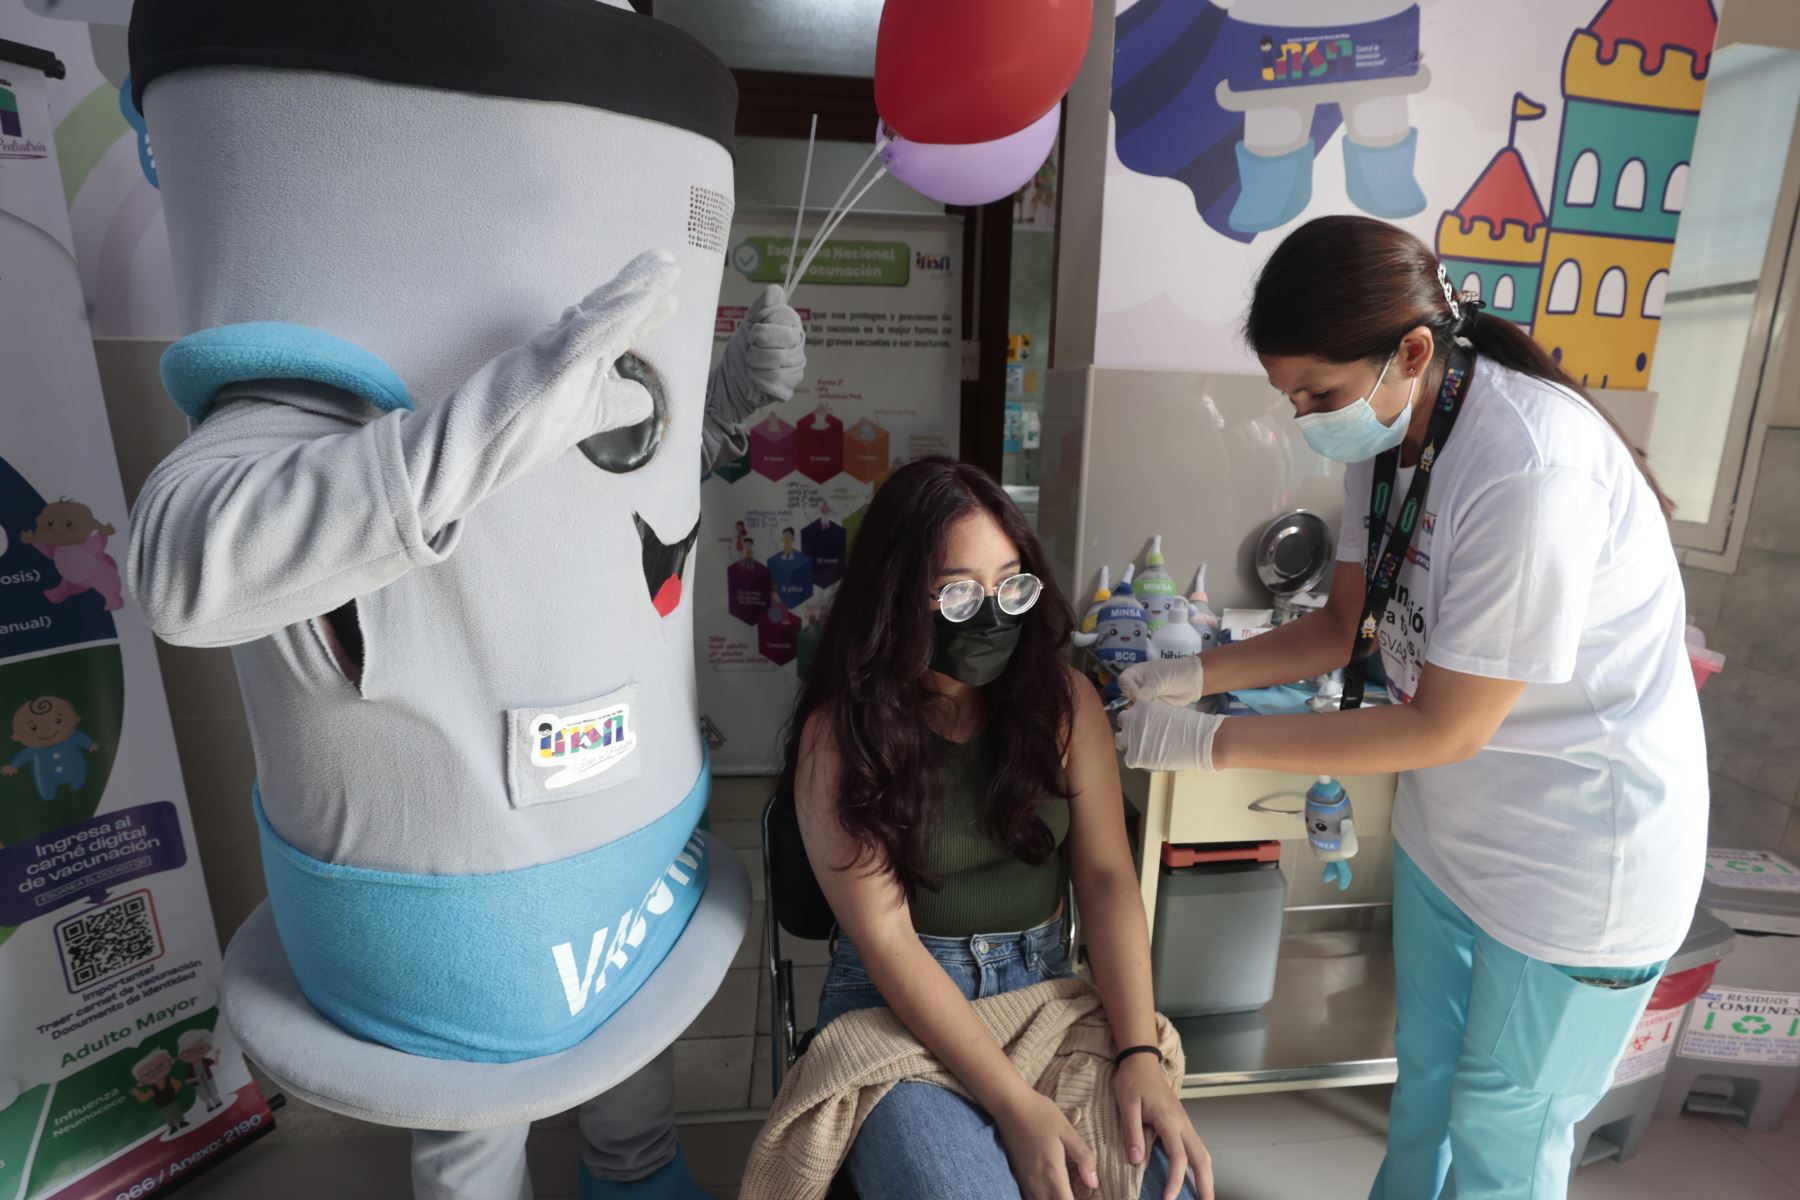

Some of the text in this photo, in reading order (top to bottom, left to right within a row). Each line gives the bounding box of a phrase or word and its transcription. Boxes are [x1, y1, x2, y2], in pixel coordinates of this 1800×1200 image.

[800, 264, 882, 277] acunación
[832, 246, 895, 260] Nacional
[1143, 582, 1173, 592] MINSA
[1110, 607, 1142, 618] MINSA
[1114, 651, 1137, 662] BCG
[26, 825, 148, 876] carné digital
[35, 815, 132, 858] Ingresa al
[18, 837, 161, 893] de vacunación
[36, 1011, 74, 1035] Traer
[75, 992, 118, 1017] carnet
[120, 984, 134, 998] de
[52, 1001, 124, 1040] Documento
[126, 994, 141, 1006] de
[1727, 993, 1789, 1006] RESIDUOS
[60, 995, 199, 1068] Adulto Mayor
[52, 1095, 127, 1138] Neumococo
[53, 1087, 121, 1127] Influenza
[169, 1139, 223, 1177] Anexo:
[223, 1113, 263, 1144] 2190
